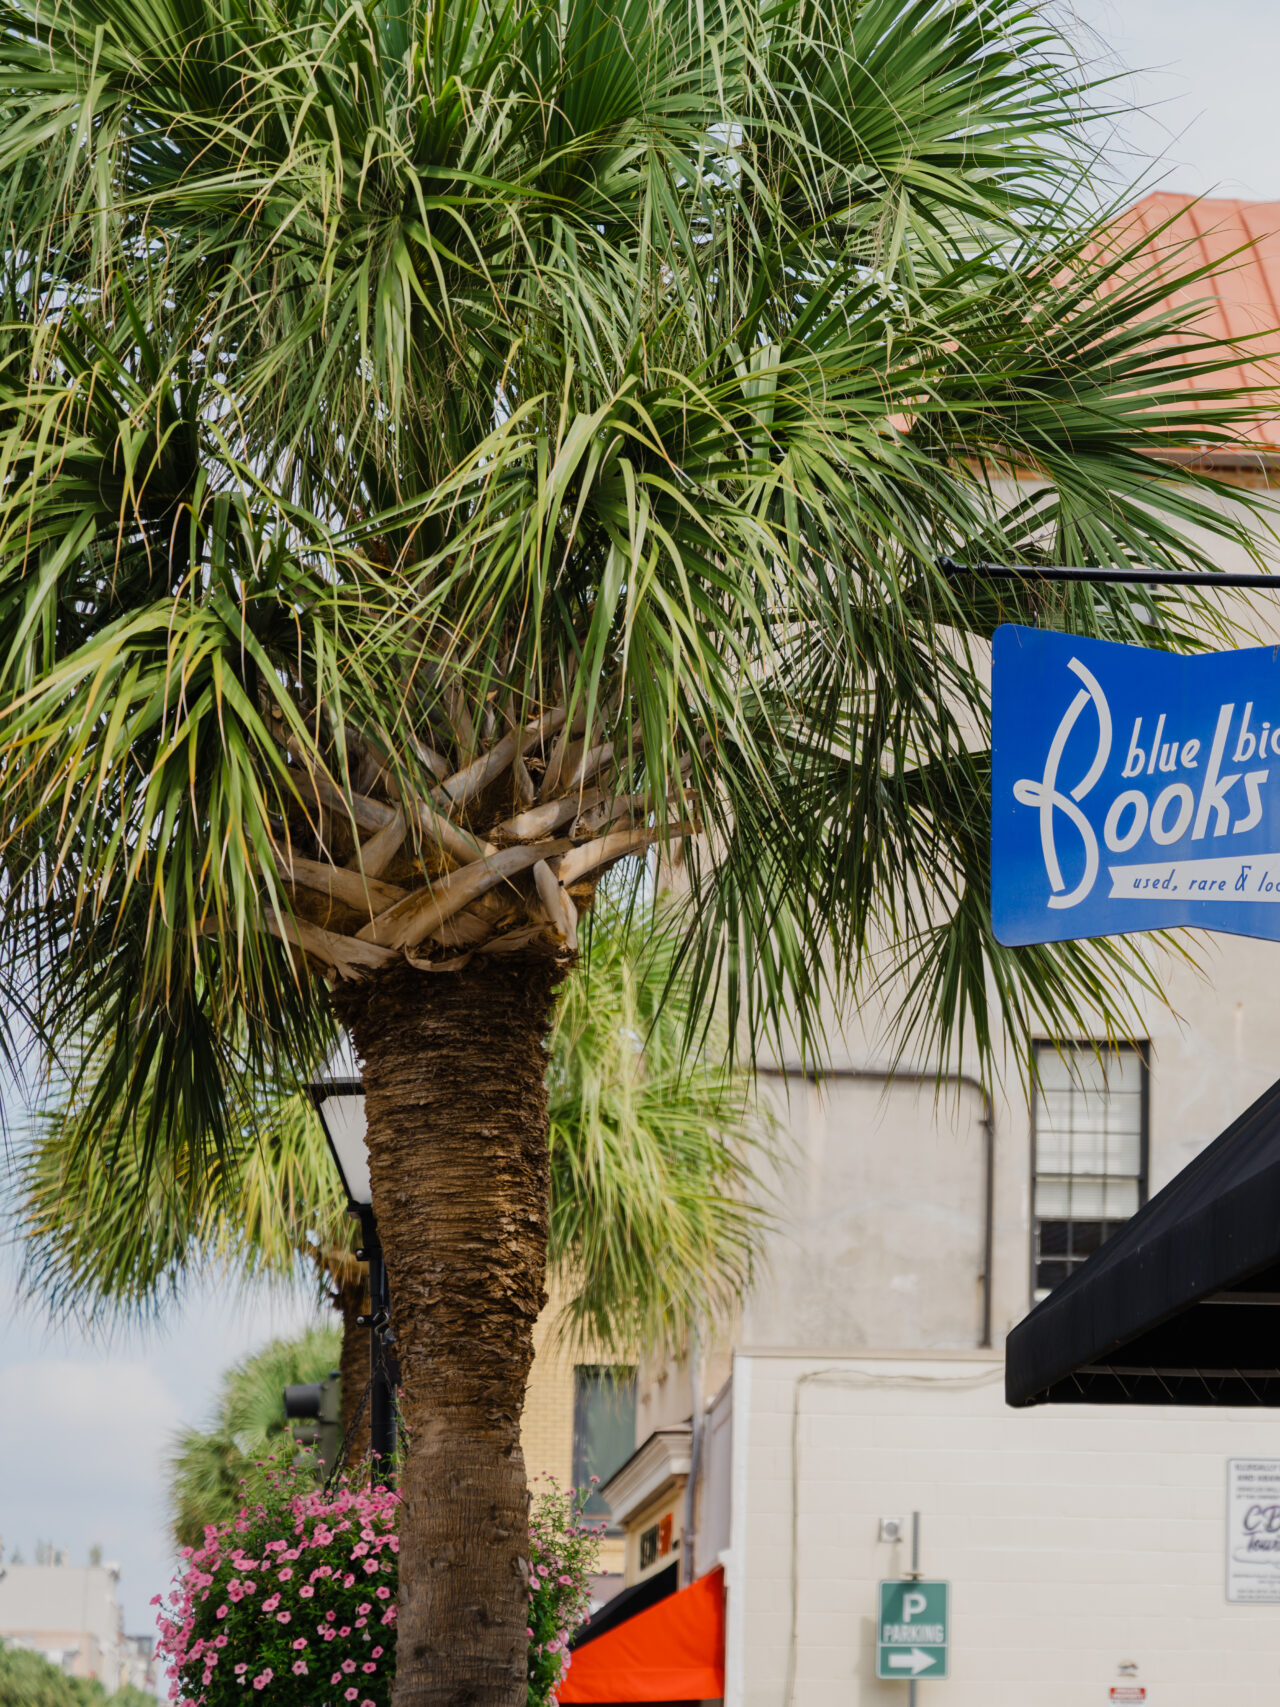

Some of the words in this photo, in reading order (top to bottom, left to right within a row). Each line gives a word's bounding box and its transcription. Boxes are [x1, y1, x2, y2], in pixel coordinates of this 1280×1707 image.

[1121, 713, 1200, 779] blue
[1013, 656, 1270, 910] Books
[1133, 869, 1179, 892] used,
[1189, 876, 1226, 892] rare
[902, 1593, 928, 1623] P
[882, 1625, 945, 1643] PARKING
